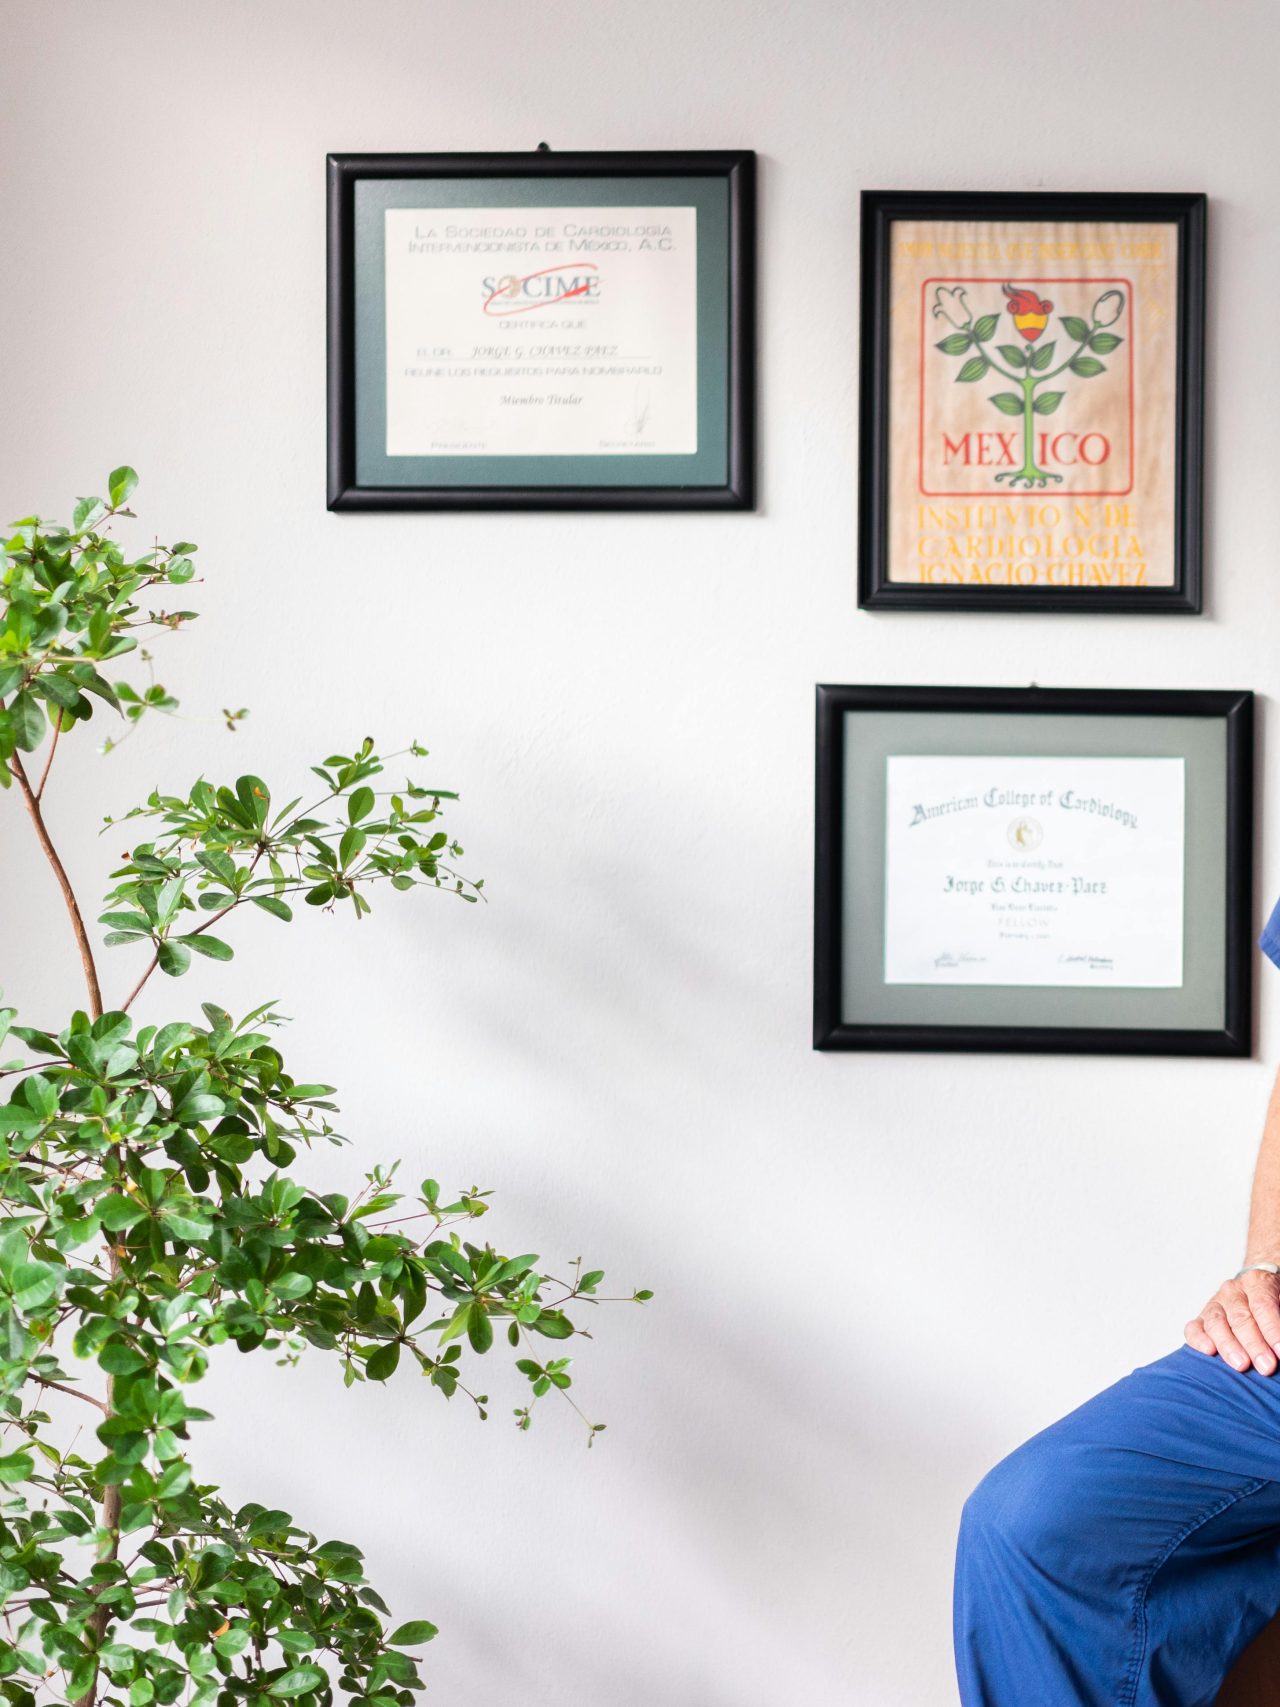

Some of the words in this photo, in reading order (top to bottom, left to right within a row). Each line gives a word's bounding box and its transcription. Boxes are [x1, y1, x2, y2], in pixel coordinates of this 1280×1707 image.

[535, 226, 556, 239] DE
[907, 796, 980, 830] American
[982, 786, 1036, 809] College
[1039, 788, 1055, 807] of
[1058, 789, 1139, 830] Cardiology
[943, 874, 985, 896] Jorge
